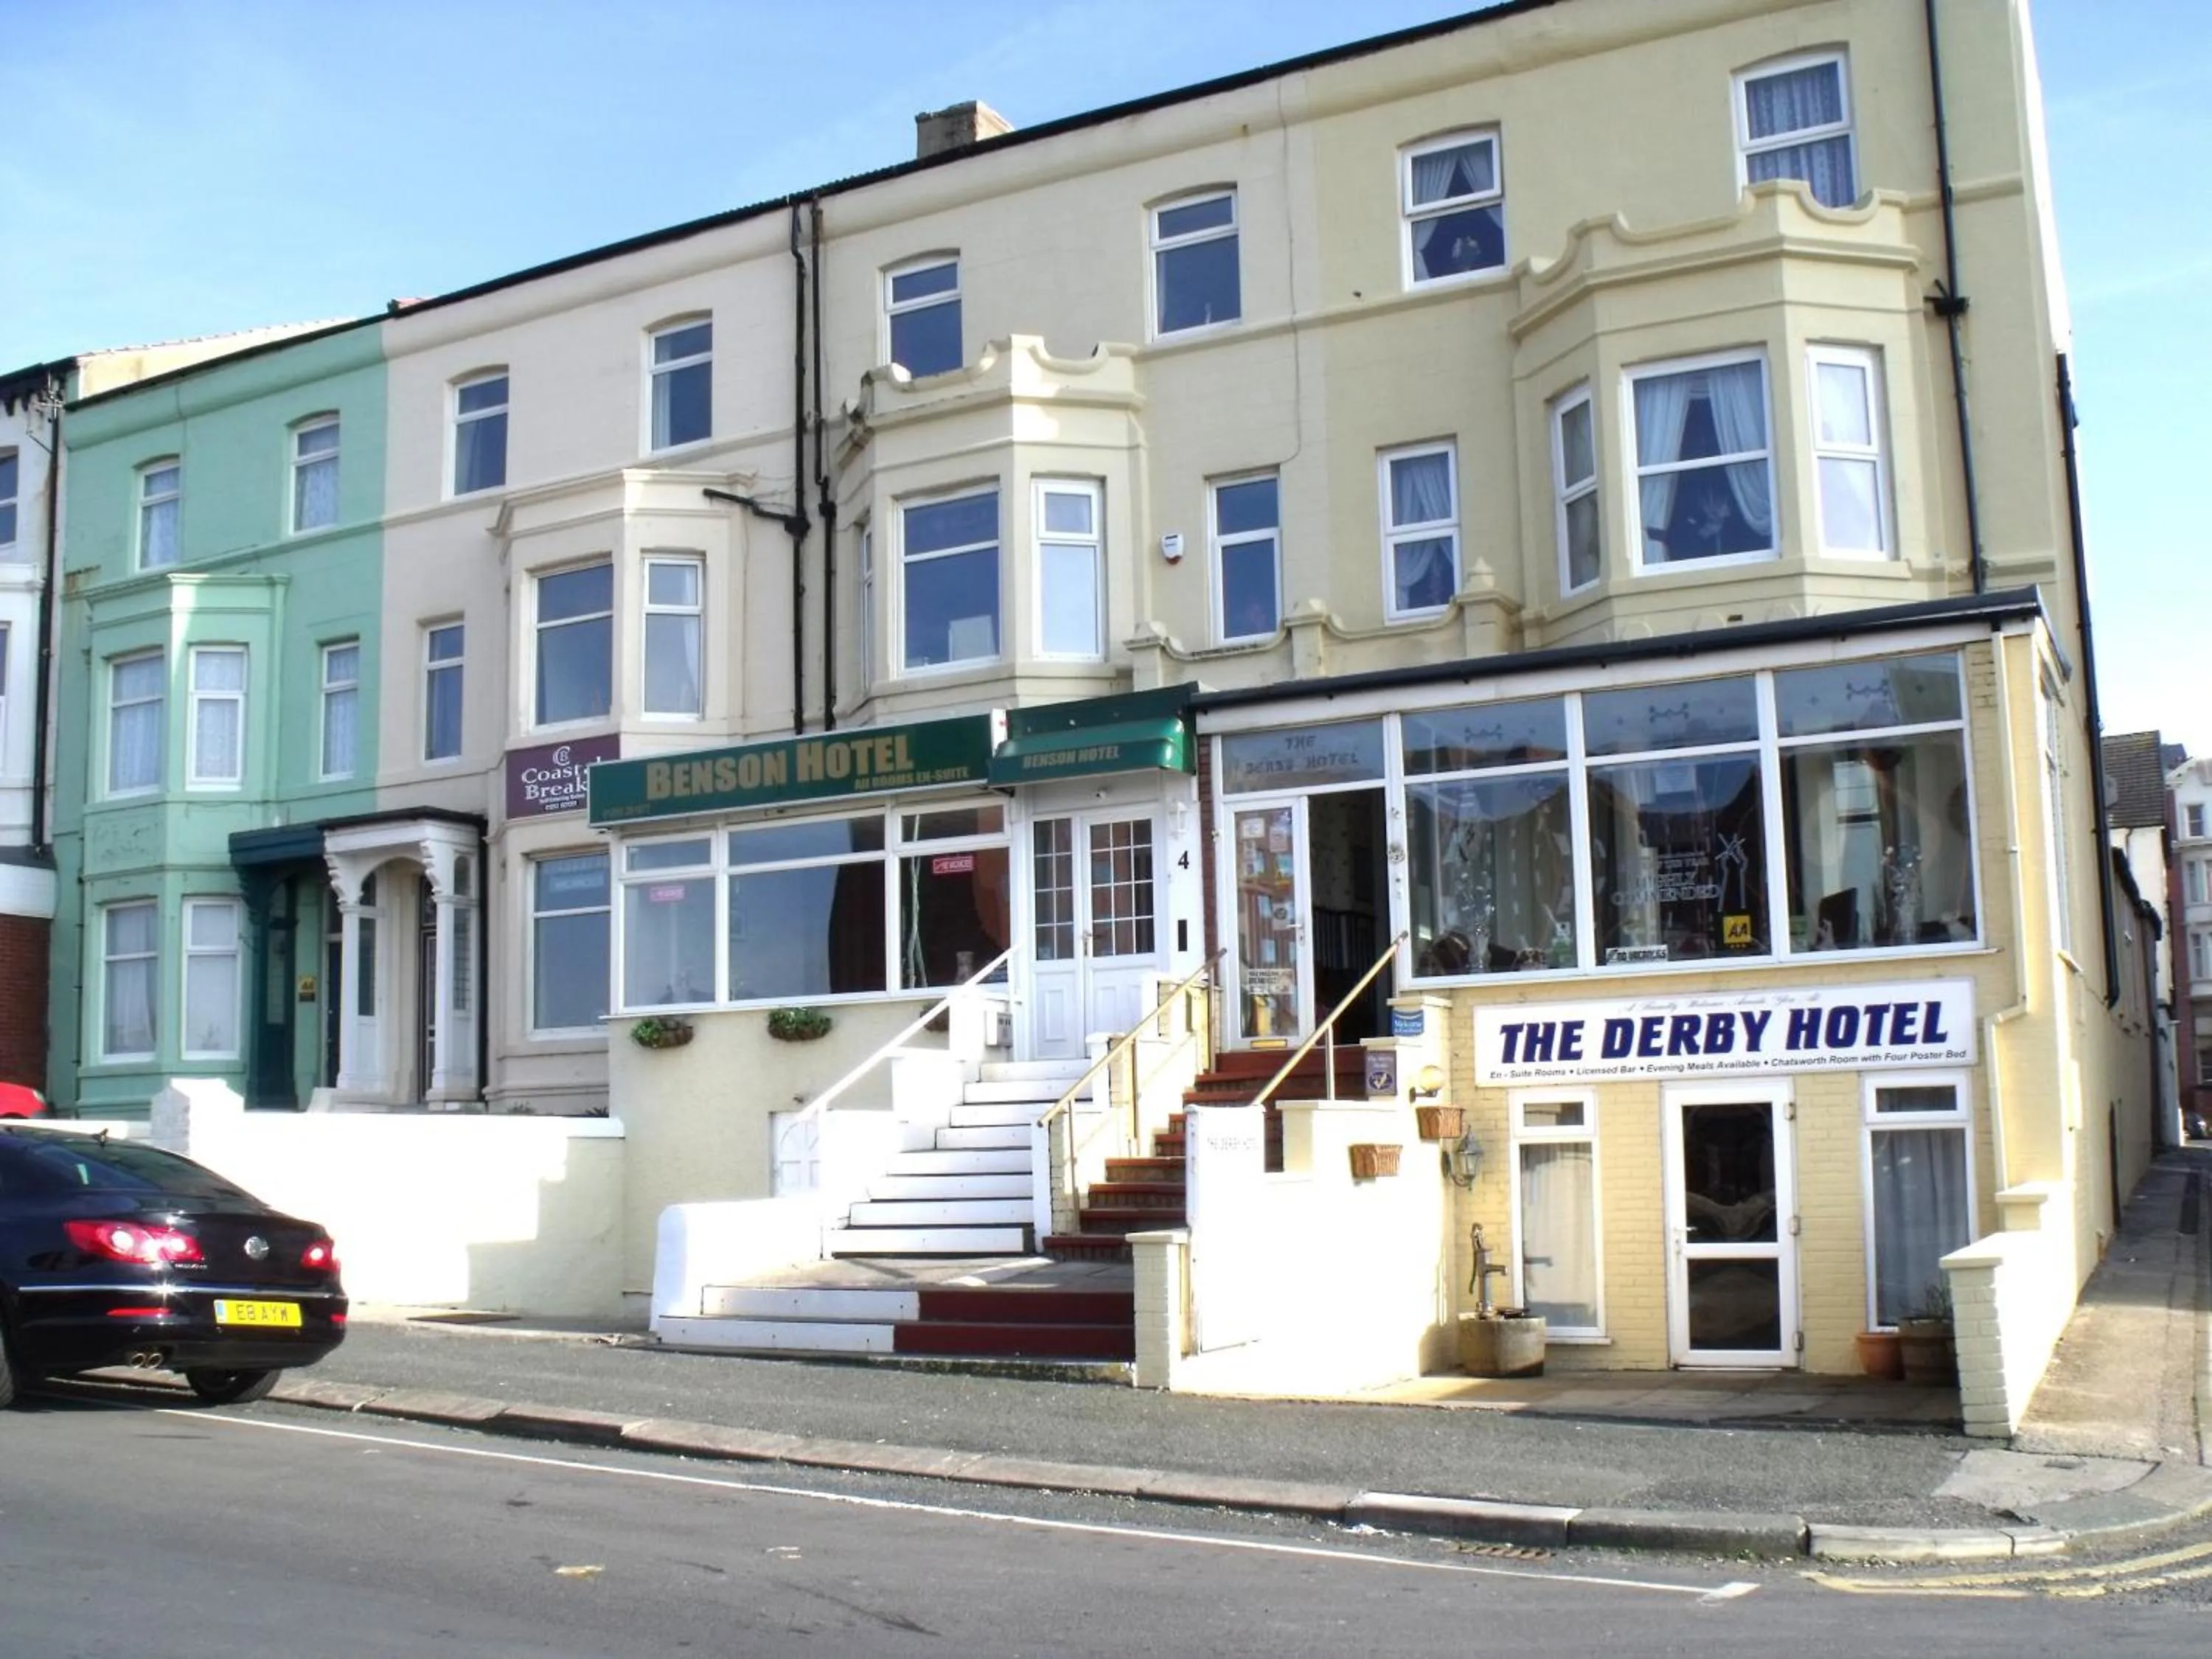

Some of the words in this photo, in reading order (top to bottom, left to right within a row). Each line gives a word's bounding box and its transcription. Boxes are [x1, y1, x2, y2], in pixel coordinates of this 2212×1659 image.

[646, 750, 787, 801] BENSON
[796, 736, 914, 783] HOTEL
[1023, 750, 1077, 769] BENSON
[1078, 745, 1120, 764] HOTEL
[1307, 752, 1360, 769] HOTEL
[521, 757, 602, 784] Coast
[525, 776, 588, 800] Break
[1178, 850, 1189, 870] 4
[1728, 922, 1747, 939] AA
[1499, 1020, 1585, 1064] THE
[1601, 1010, 1772, 1060] DERBY
[1786, 1001, 1949, 1051] HOTEL
[1510, 1069, 1532, 1078] Suite
[1534, 1068, 1566, 1077] Rooms
[1576, 1066, 1618, 1075] Licensed
[1621, 1065, 1636, 1074] Bar
[1646, 1063, 1685, 1074] Evening
[1687, 1062, 1714, 1071] Meals
[1717, 1059, 1761, 1070] Available
[1771, 1056, 1827, 1067] Chatsworth
[1829, 1054, 1859, 1064] Room
[1860, 1053, 1882, 1062] with
[1884, 1051, 1908, 1062] Four
[1910, 1050, 1944, 1060] Poster
[1945, 1049, 1966, 1059] Bed
